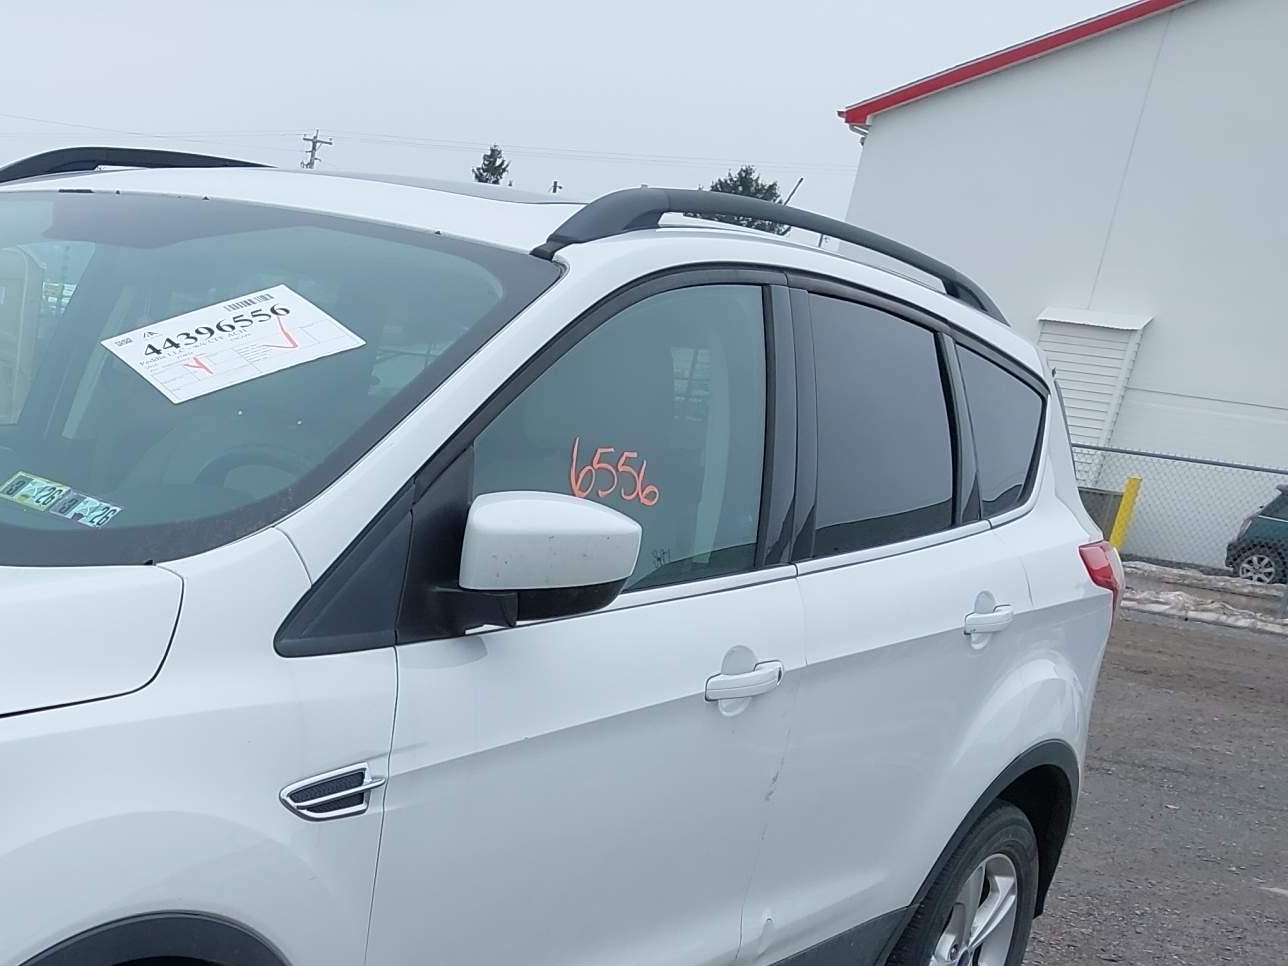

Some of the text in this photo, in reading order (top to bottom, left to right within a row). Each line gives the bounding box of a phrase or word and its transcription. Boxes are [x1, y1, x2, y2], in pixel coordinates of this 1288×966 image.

[143, 303, 291, 358] 44396556
[570, 437, 659, 506] 6556
[35, 485, 63, 506] 26
[88, 506, 117, 526] 26
